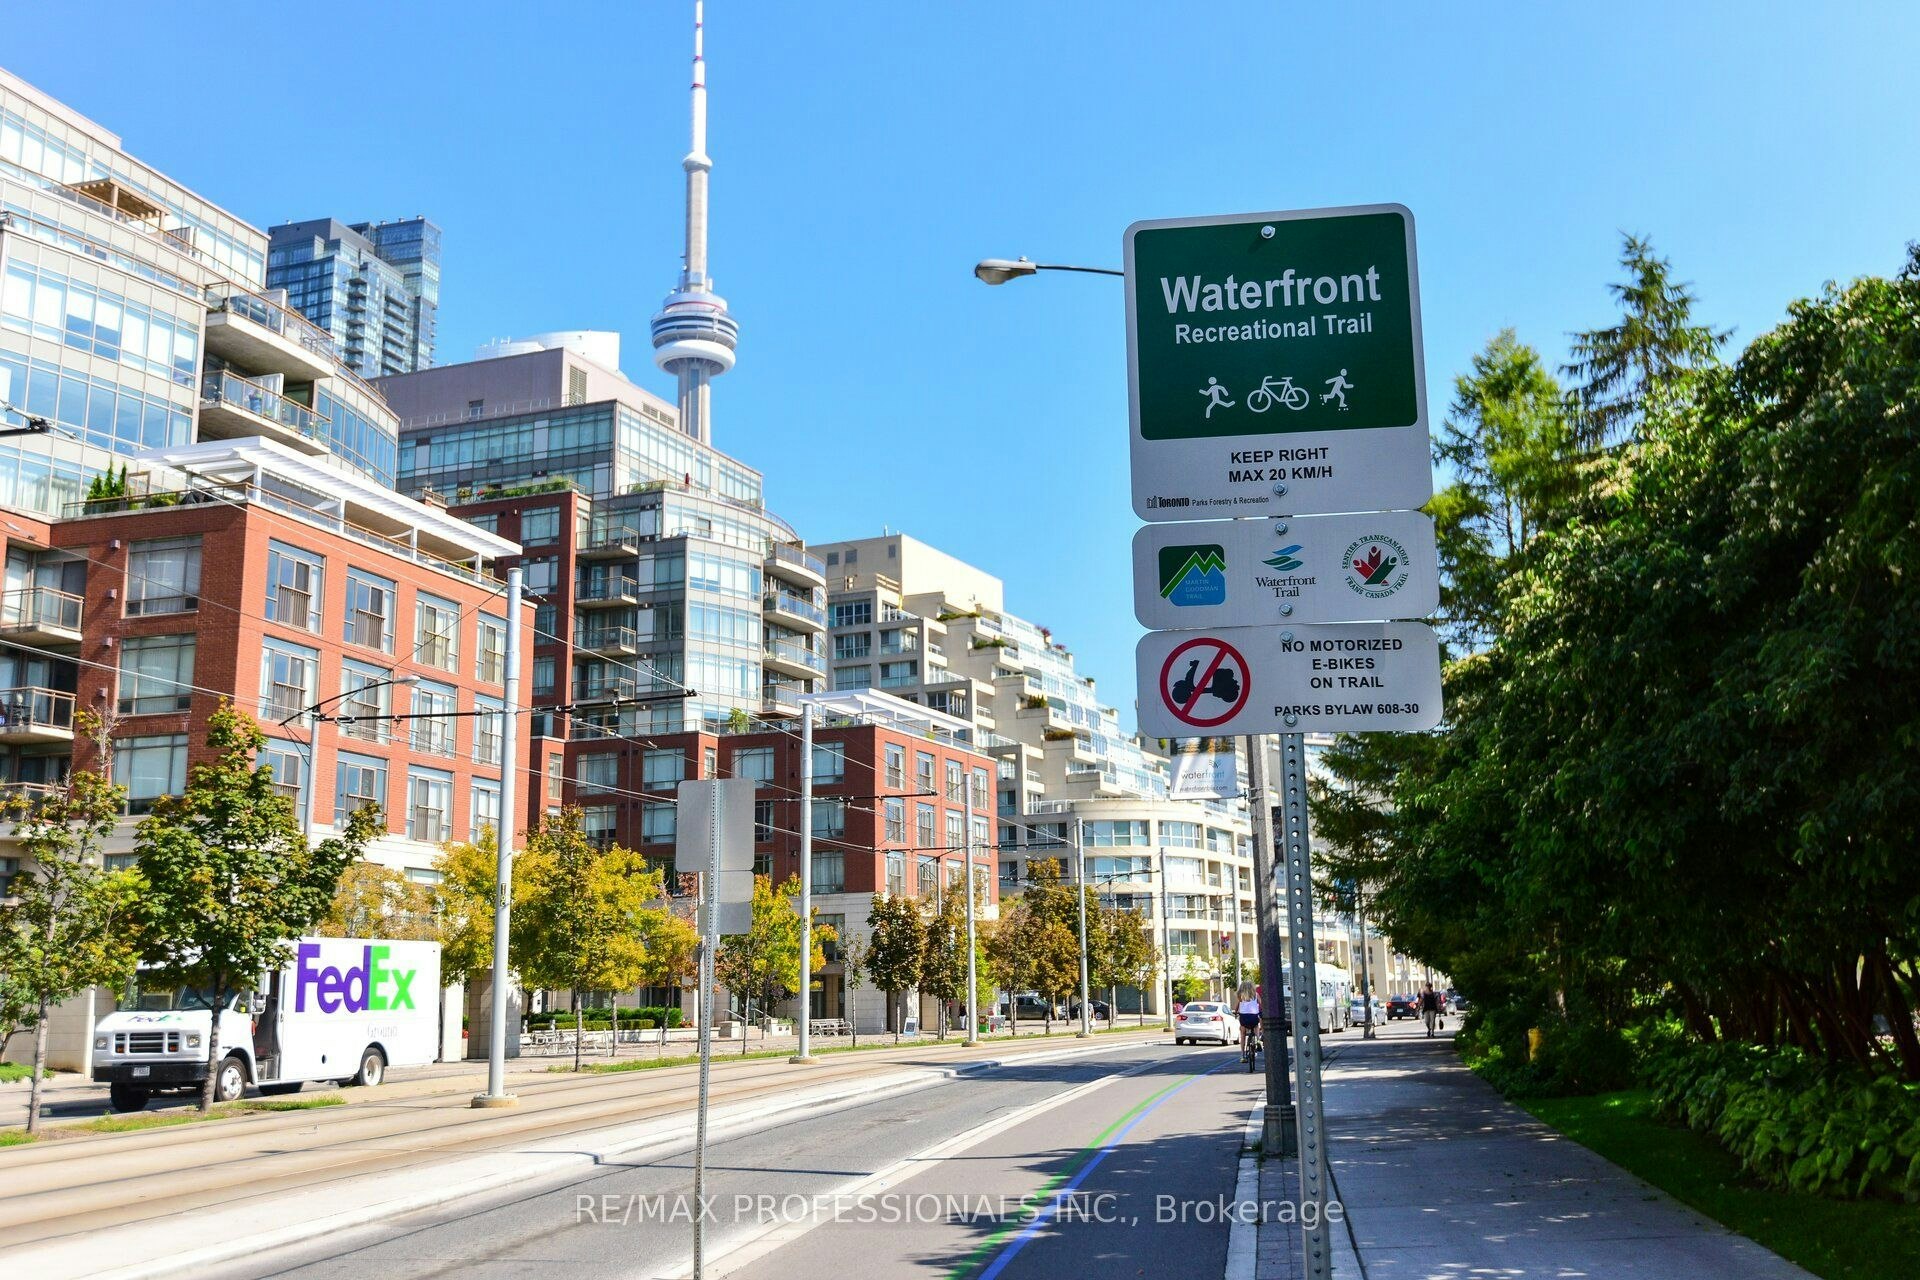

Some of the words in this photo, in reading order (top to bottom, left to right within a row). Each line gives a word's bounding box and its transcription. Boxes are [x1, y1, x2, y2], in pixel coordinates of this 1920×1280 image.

[1161, 265, 1381, 314] Waterfront
[1175, 316, 1316, 344] Recreational
[1323, 312, 1373, 335] Trail
[1231, 450, 1274, 464] KEEP
[1279, 447, 1329, 462] RIGHT
[1228, 468, 1264, 483] MAX
[1269, 468, 1287, 481] 20
[1291, 465, 1333, 479] KM/H
[1158, 497, 1190, 508] TORONTO
[1192, 499, 1208, 507] Parks
[1209, 497, 1232, 507] Forestry
[1233, 497, 1238, 505] &
[1240, 496, 1269, 504] Recreation
[1342, 541, 1359, 570] SENTIER
[1359, 534, 1410, 566] TRANSCANADIEN
[1255, 575, 1317, 588] Waterfront
[1345, 576, 1364, 595] TRANS
[1365, 589, 1395, 599] CANADA
[1393, 572, 1409, 591] TRAIL
[1272, 587, 1300, 598] Trail
[1281, 639, 1305, 653] NO
[1309, 638, 1403, 652] MOTORIZED
[1312, 657, 1375, 670] E-BIKES
[1310, 676, 1333, 689] ON
[1337, 675, 1384, 688] TRAIL
[1274, 703, 1321, 717] PARKS
[1325, 703, 1373, 716] BYLAW
[1377, 703, 1420, 715] 608-30
[1181, 770, 1225, 779] waterfront
[295, 942, 416, 1014] FedEx
